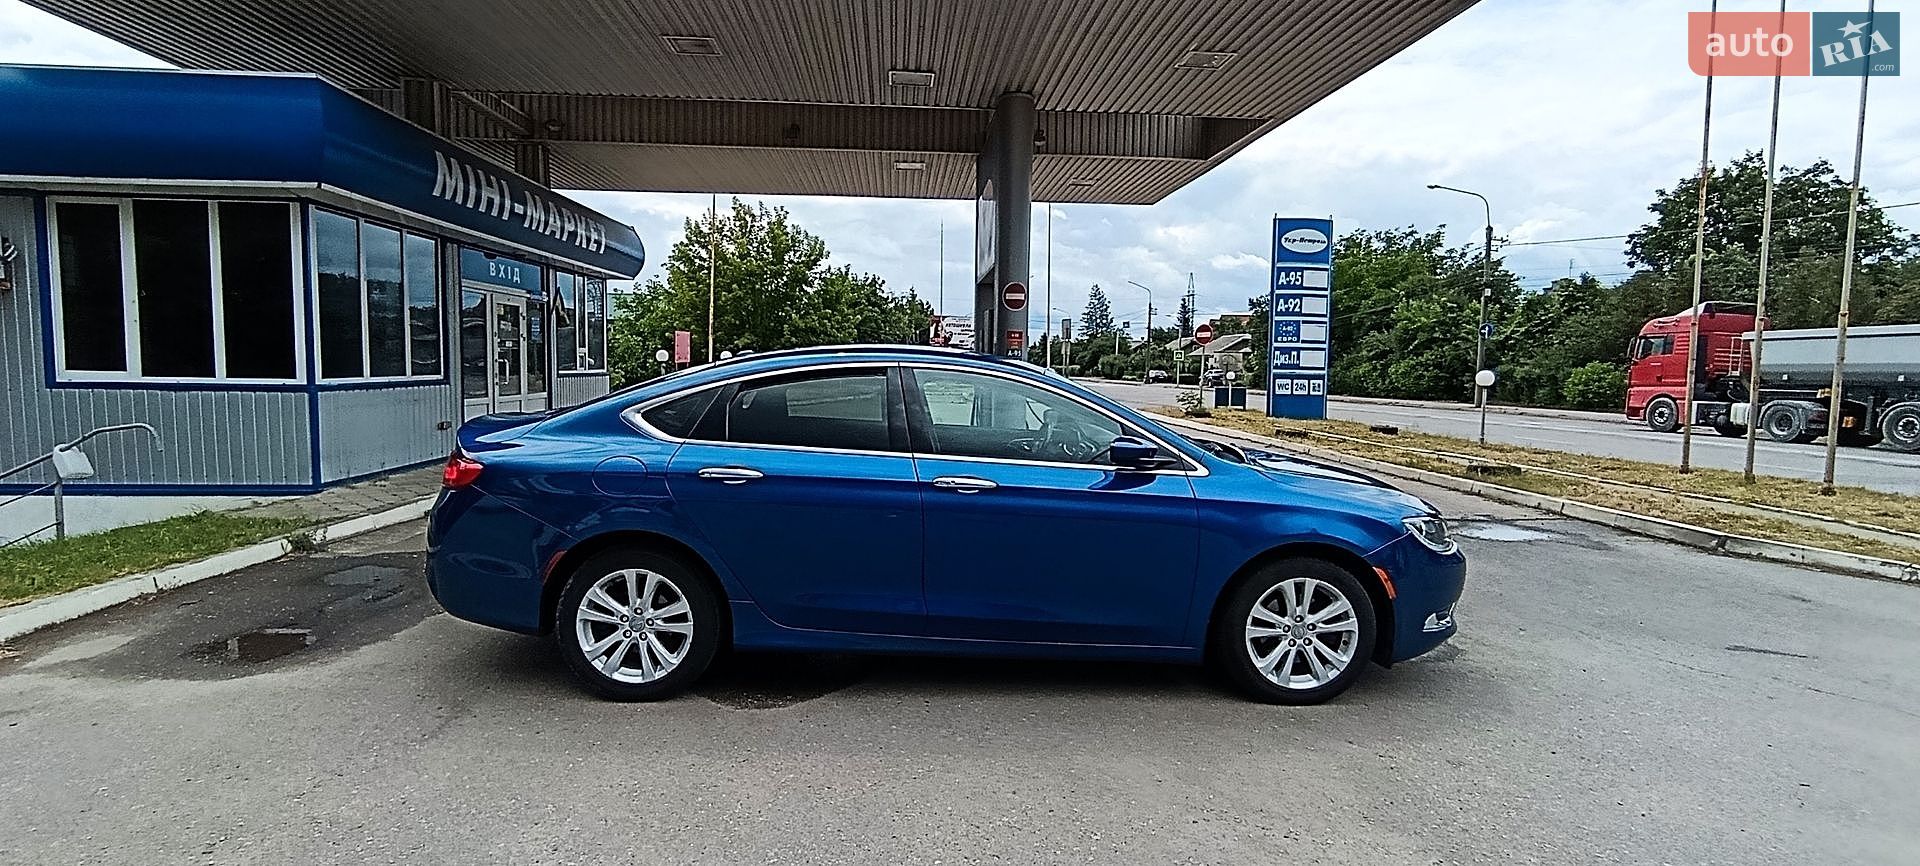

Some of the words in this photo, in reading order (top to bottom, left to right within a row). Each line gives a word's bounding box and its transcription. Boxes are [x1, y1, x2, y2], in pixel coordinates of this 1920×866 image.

[432, 150, 607, 254] МІНІ-МАРКЕТ
[489, 261, 521, 284] ВХІД
[1278, 271, 1302, 285] А-95
[1277, 299, 1300, 312] А-92
[1277, 382, 1290, 391] WC
